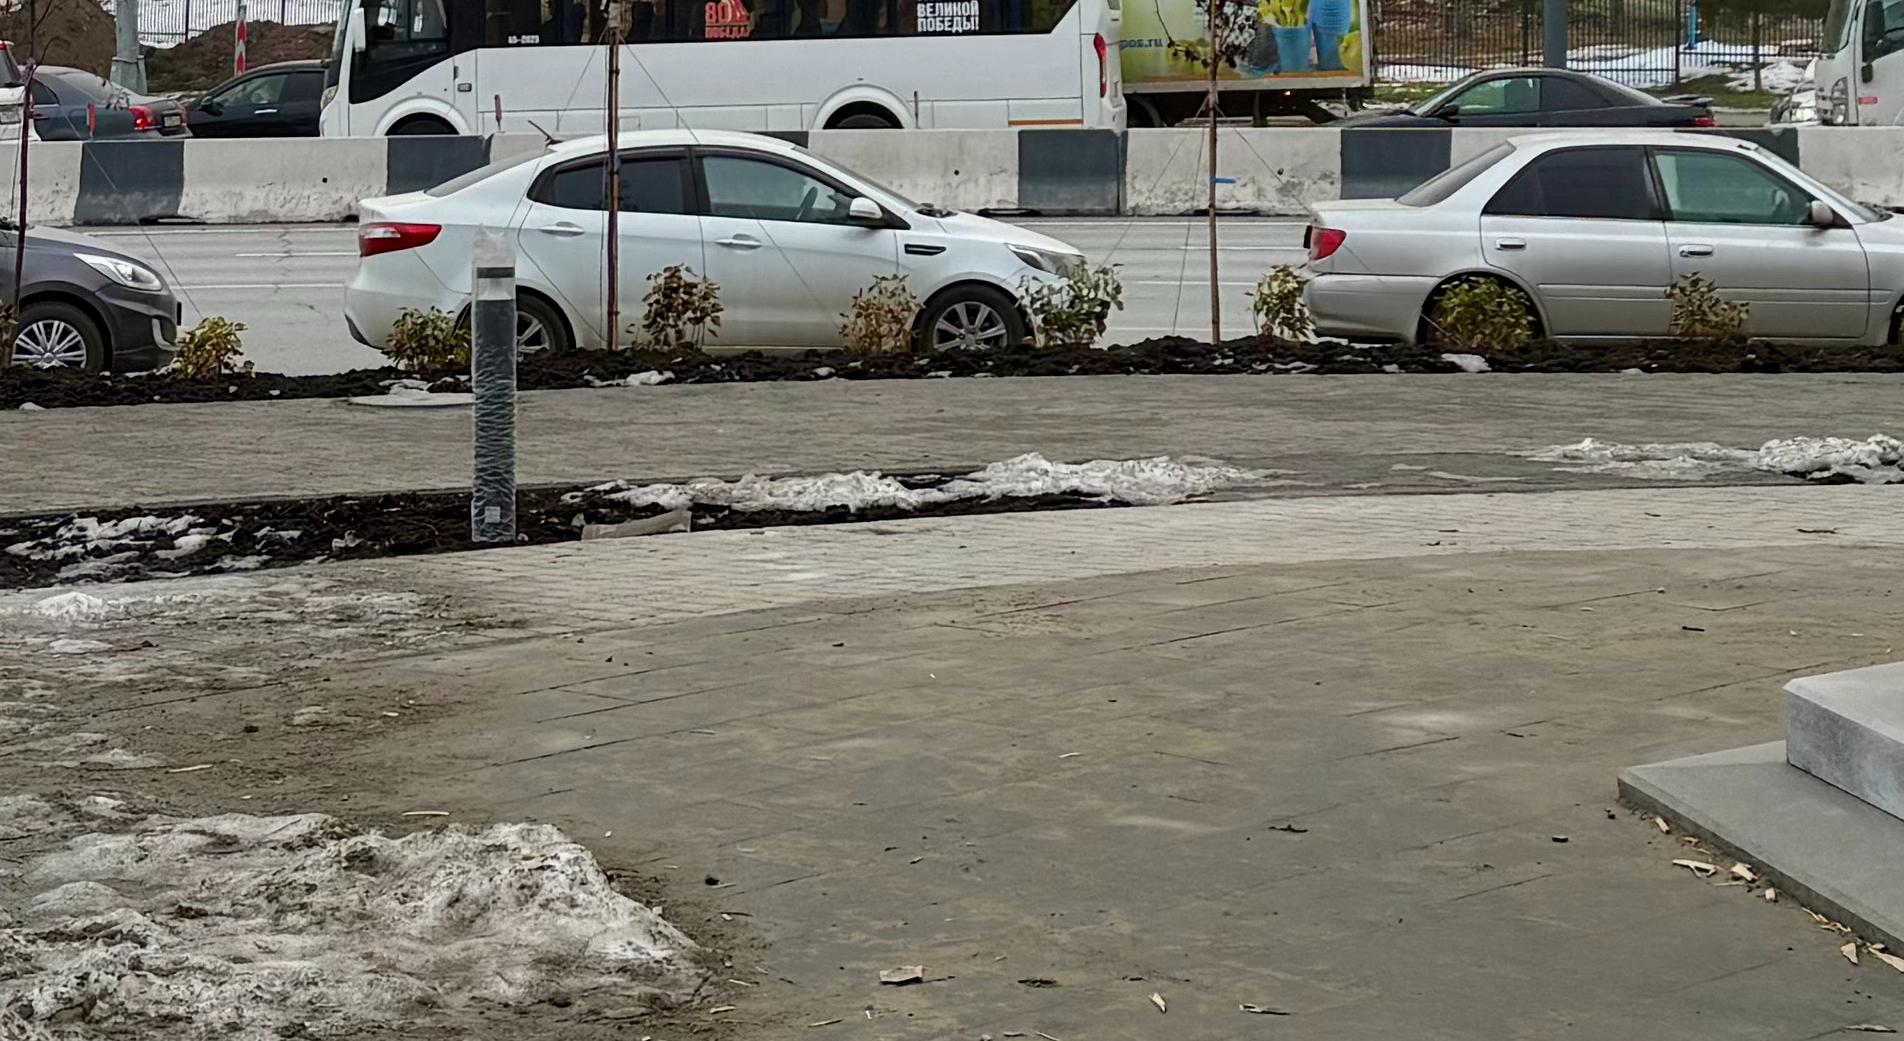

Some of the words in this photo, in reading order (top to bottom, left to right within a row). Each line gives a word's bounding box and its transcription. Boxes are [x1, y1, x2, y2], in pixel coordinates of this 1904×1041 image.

[705, 1, 730, 25] 80
[917, 0, 979, 17] ВЕЛИКОЙ
[917, 16, 979, 33] ПОБЕДЫ!
